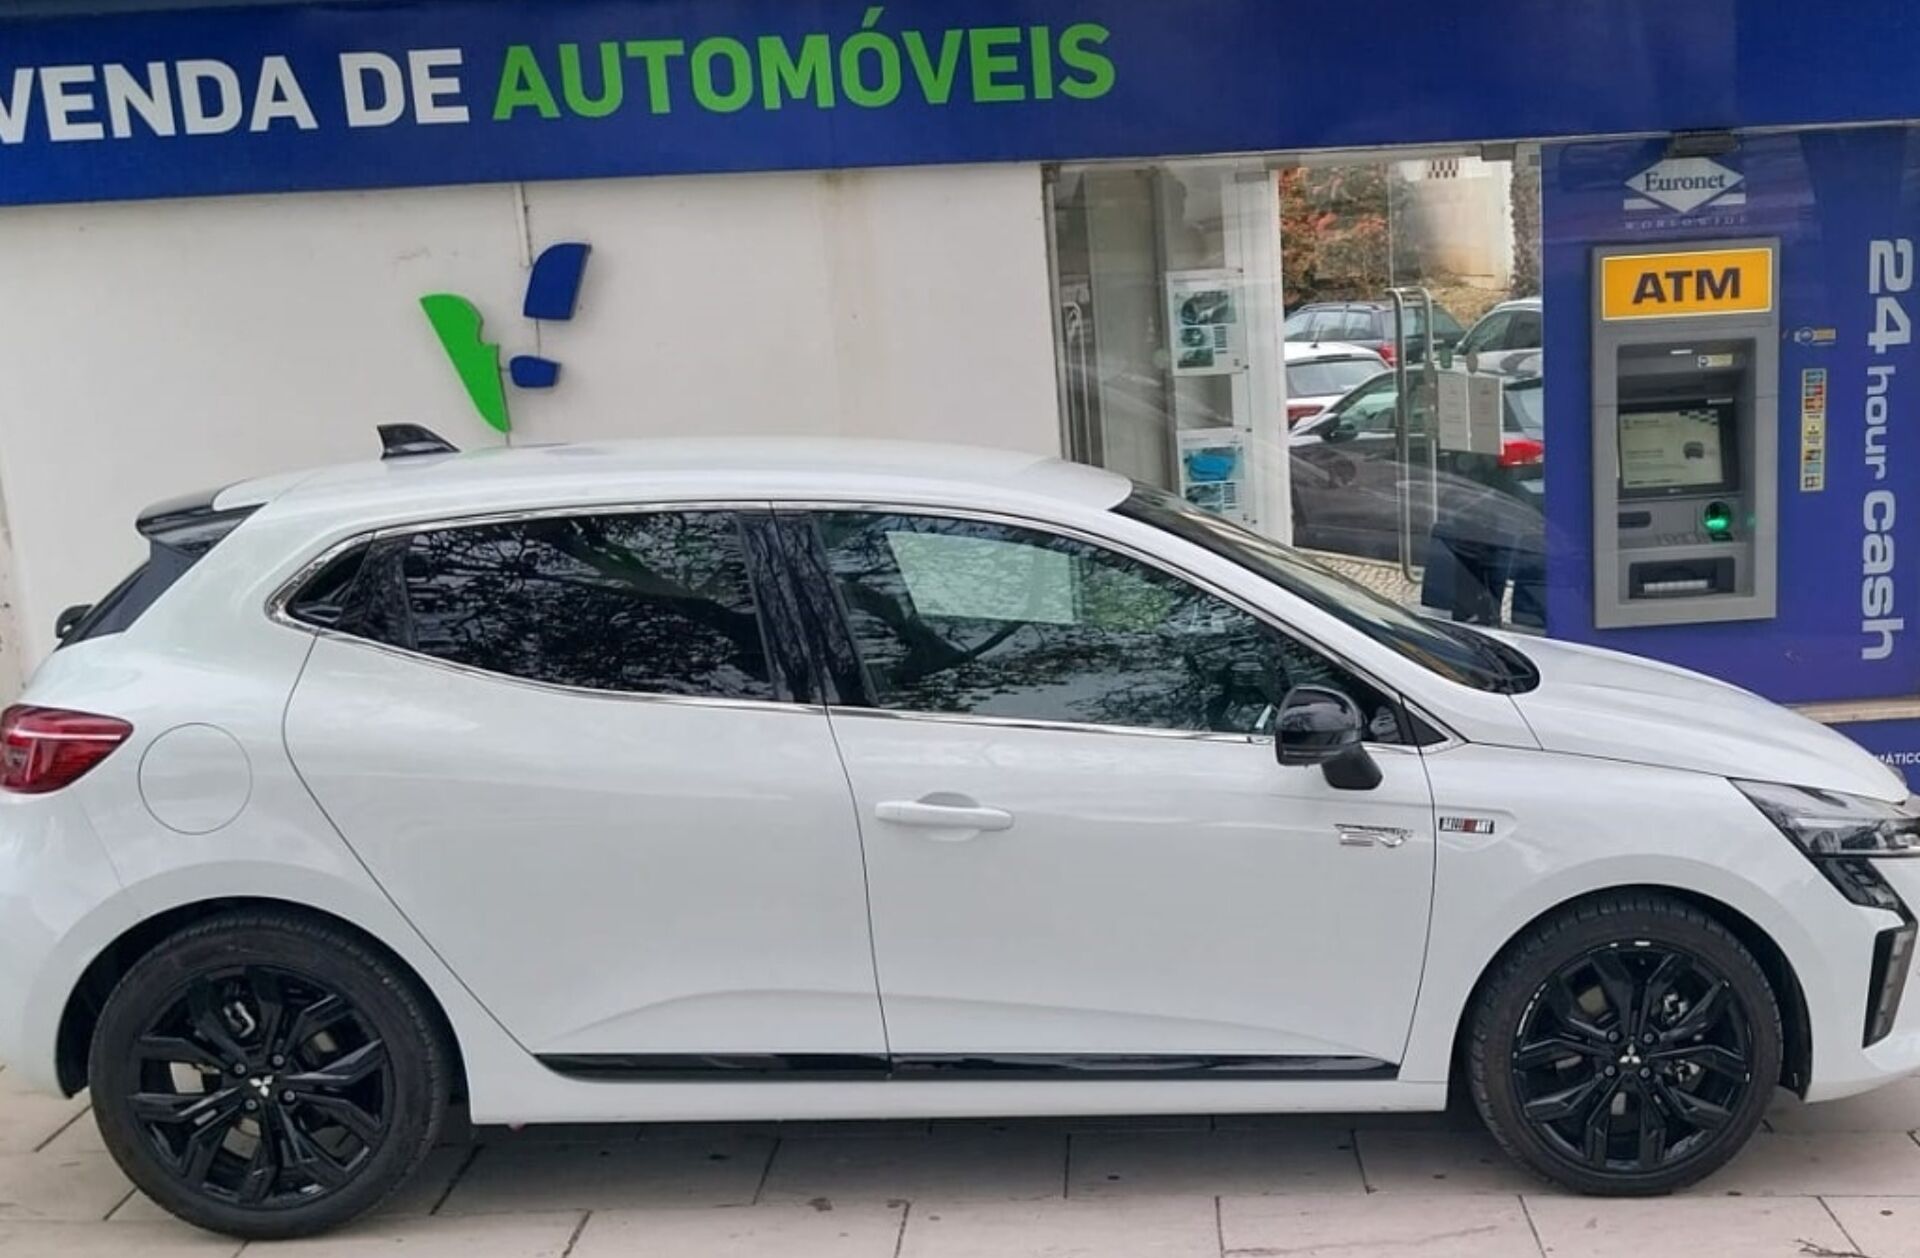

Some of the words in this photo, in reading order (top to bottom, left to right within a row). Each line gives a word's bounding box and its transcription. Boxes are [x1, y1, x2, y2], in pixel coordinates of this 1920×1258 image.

[0, 55, 318, 144] VENDA
[339, 48, 470, 128] DE
[491, 6, 1116, 121] AUTOMÓVEIS
[1644, 172, 1727, 192] Euronet
[1632, 267, 1741, 305] ATM
[1867, 238, 1914, 354] 24
[1865, 365, 1896, 480] hour
